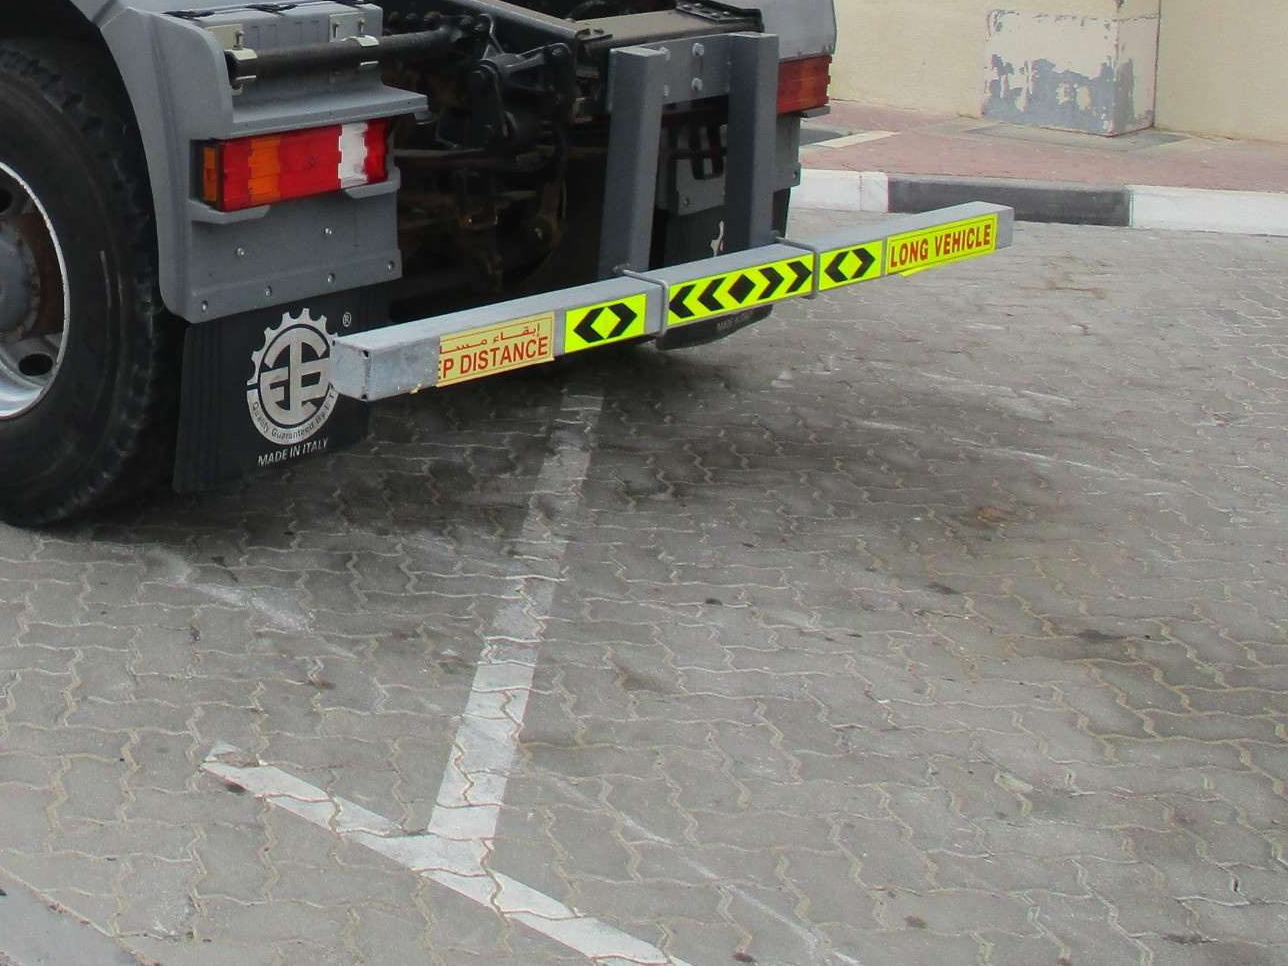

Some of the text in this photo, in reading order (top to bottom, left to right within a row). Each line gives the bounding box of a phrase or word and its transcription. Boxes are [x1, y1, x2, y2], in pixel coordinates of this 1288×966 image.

[890, 224, 992, 268] LONG VEHICLE
[460, 335, 549, 375] DISTANCE
[252, 401, 270, 433] Quality
[271, 424, 315, 440] Guaranteed
[257, 437, 329, 467] MADE IN ITALY
